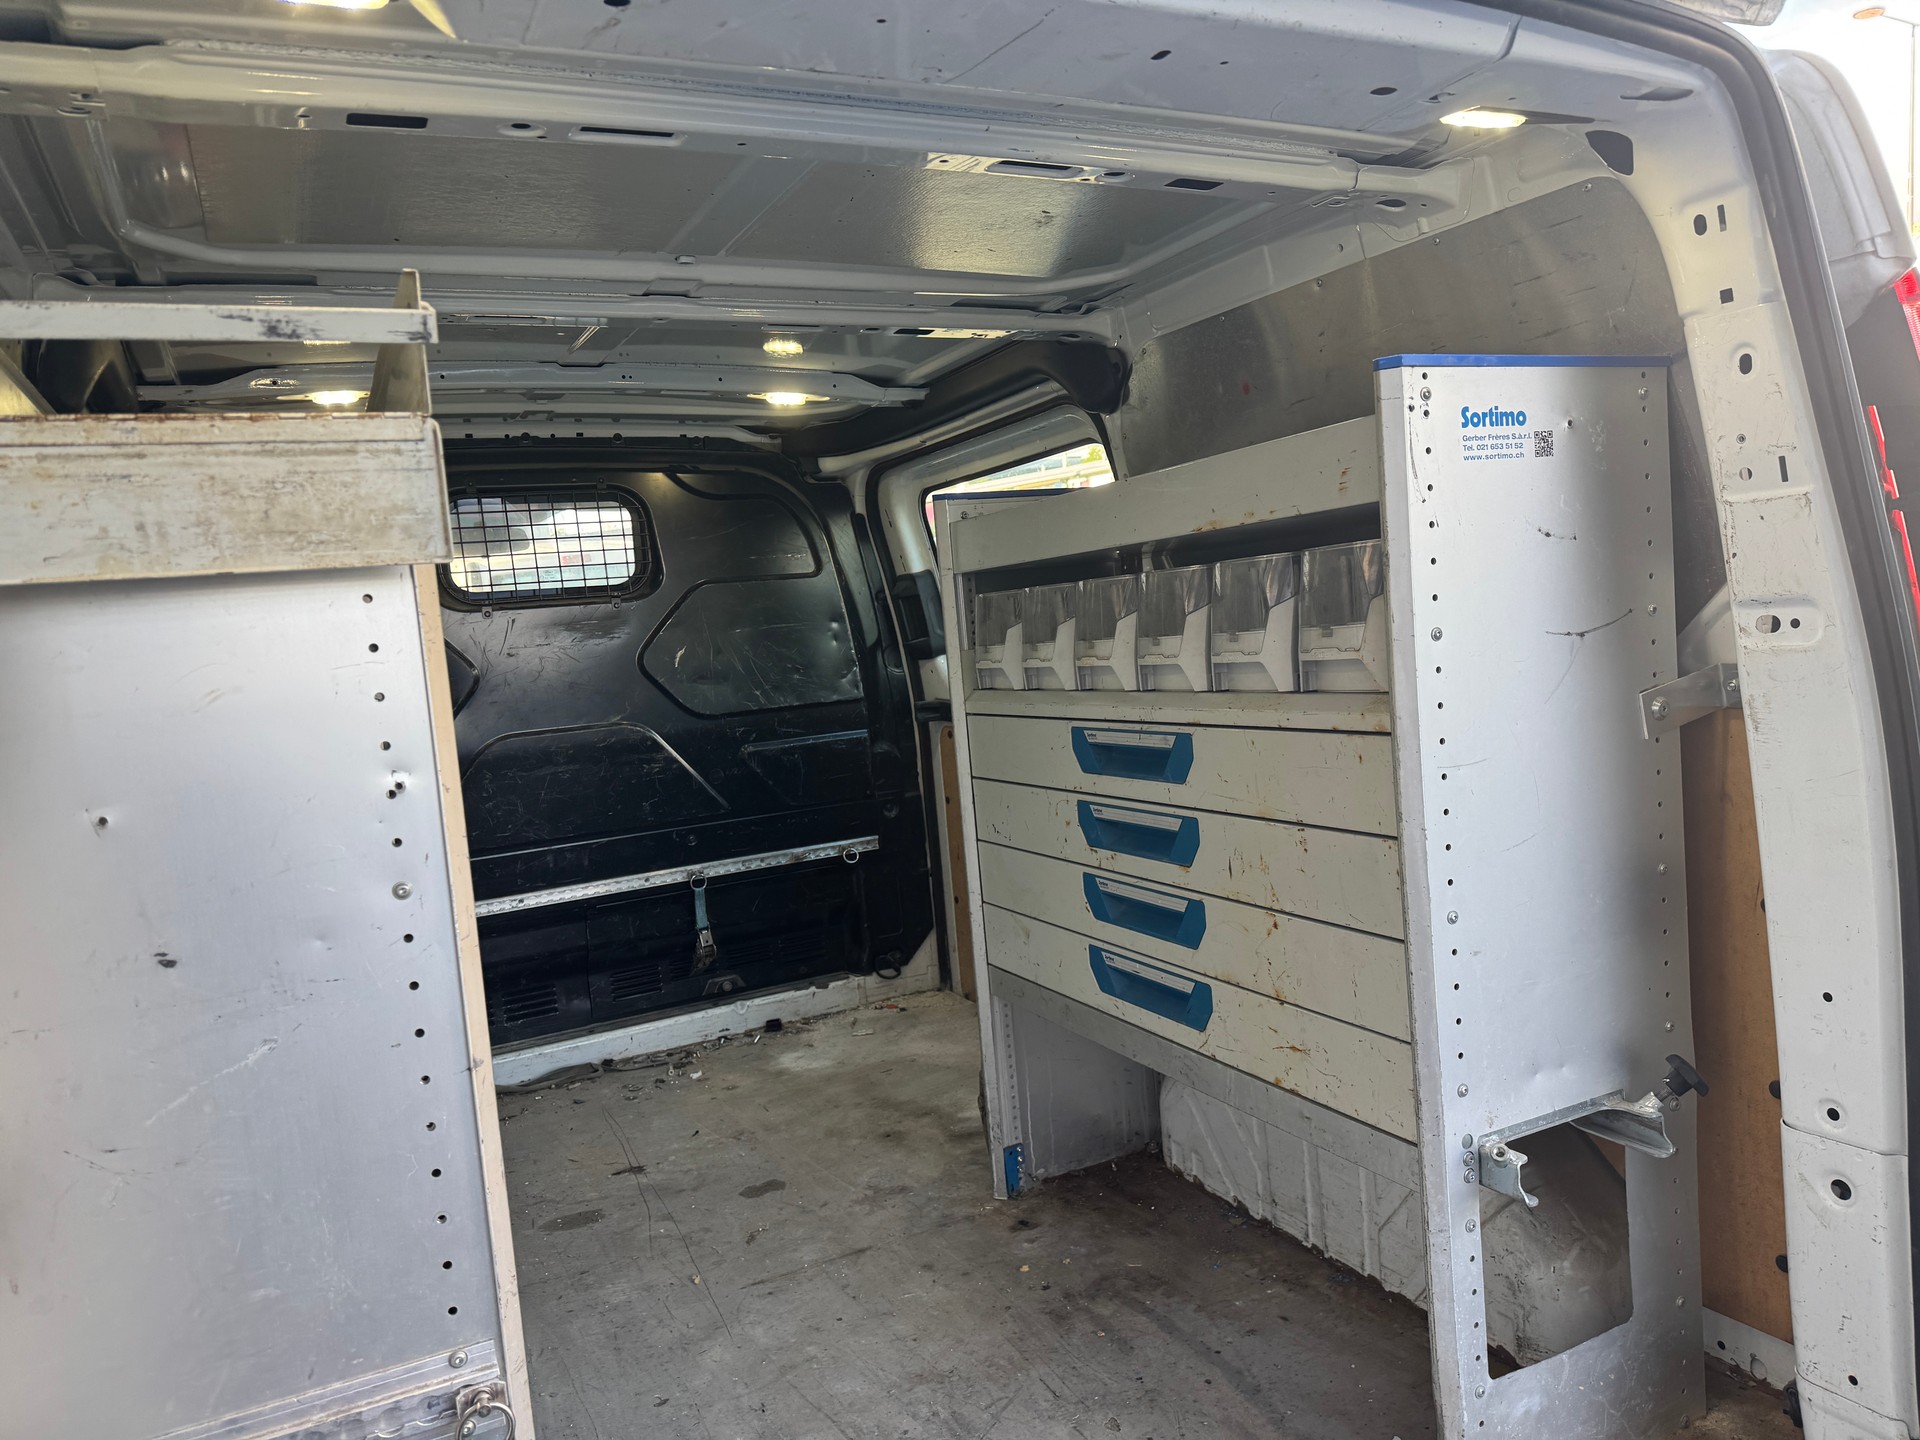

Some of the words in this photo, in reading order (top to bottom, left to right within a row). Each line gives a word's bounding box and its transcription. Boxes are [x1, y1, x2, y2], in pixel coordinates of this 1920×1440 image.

[1461, 406, 1527, 428] Sortimo
[1462, 434, 1486, 442] Gerber
[1488, 432, 1510, 441] Frères
[1463, 444, 1475, 452] Tel.
[1463, 452, 1525, 461] www.sortimo.ch
